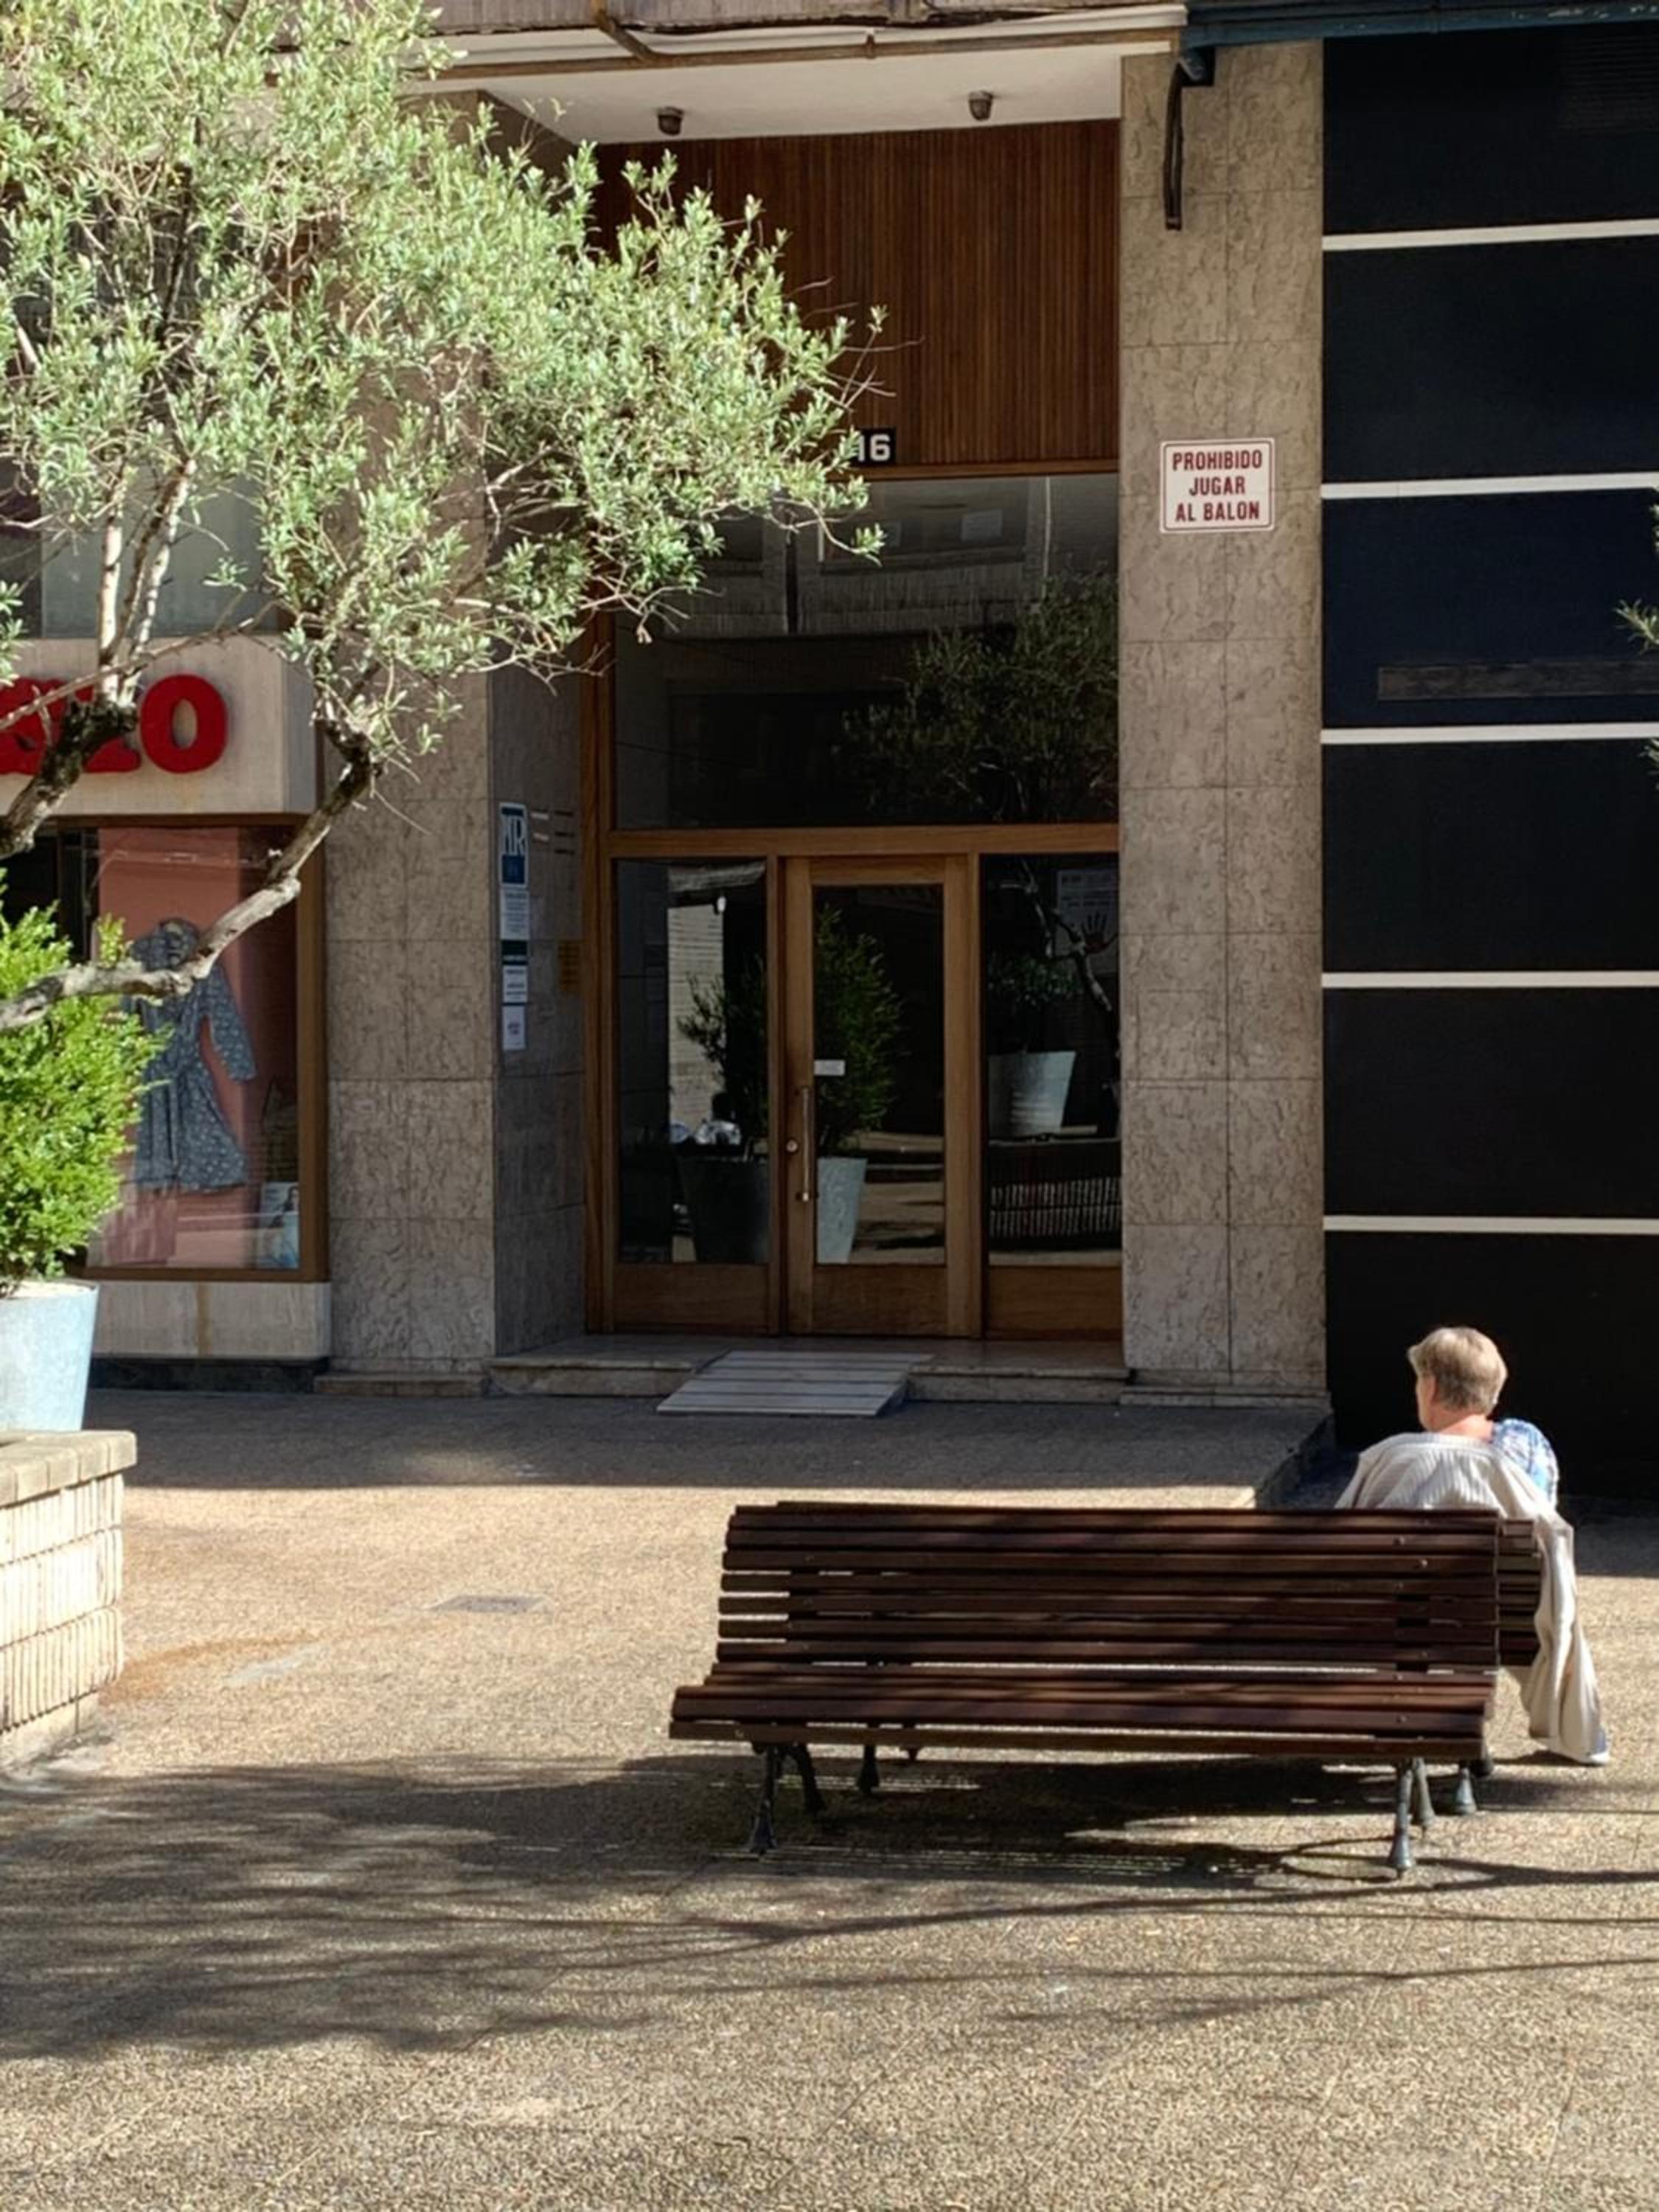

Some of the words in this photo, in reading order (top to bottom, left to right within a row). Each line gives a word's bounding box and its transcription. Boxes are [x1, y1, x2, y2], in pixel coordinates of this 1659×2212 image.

[857, 434, 891, 462] 16
[1172, 450, 1263, 471] PROHIBIDO
[1189, 476, 1245, 496] JUGAR
[1175, 503, 1196, 522] AL
[1203, 501, 1260, 521] BALON
